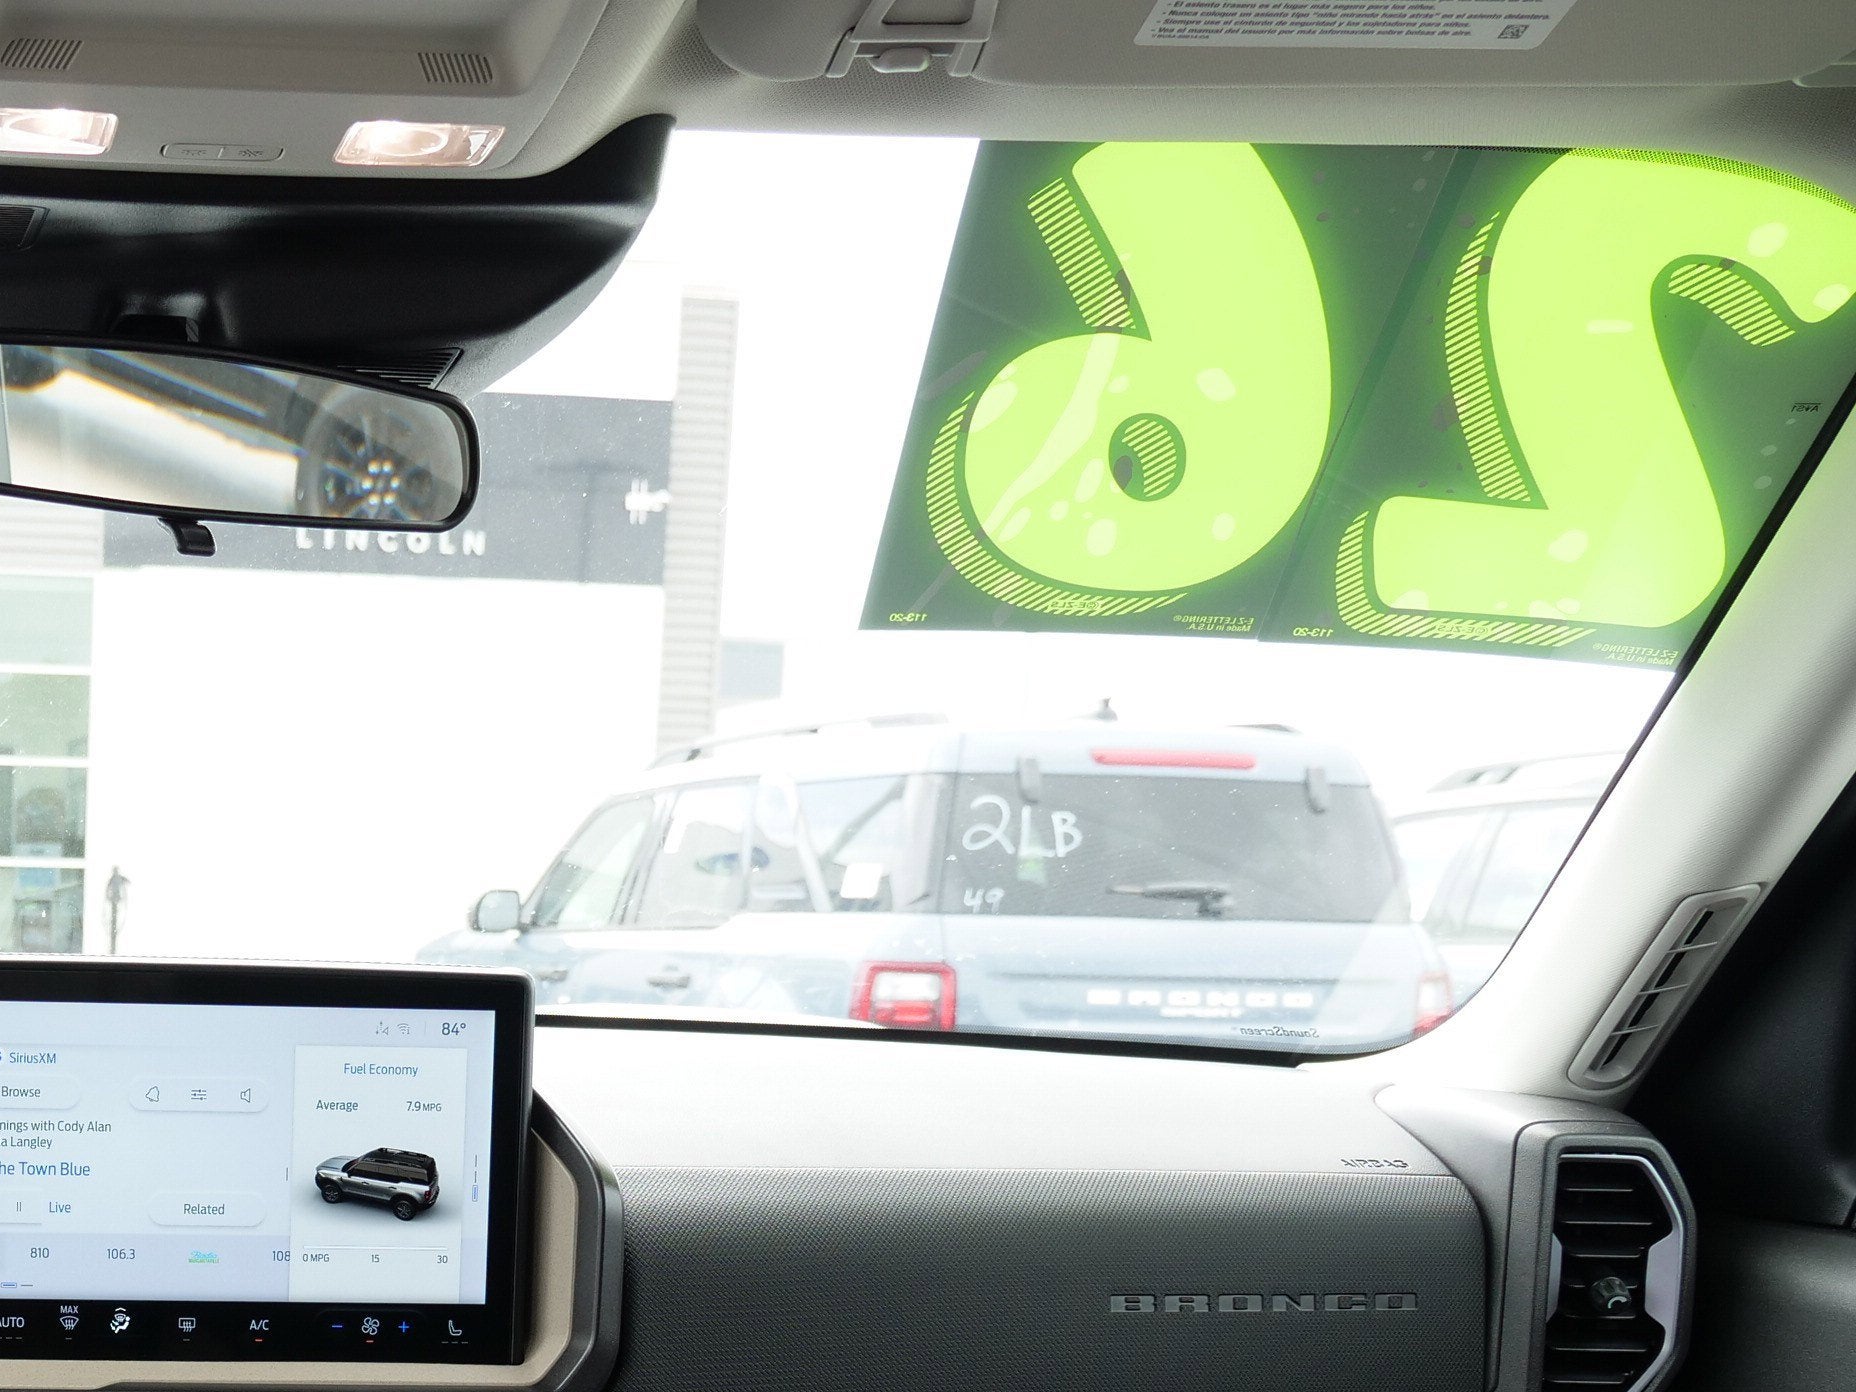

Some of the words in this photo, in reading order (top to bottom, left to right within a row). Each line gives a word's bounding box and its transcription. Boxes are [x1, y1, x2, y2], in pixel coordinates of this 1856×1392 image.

[296, 528, 486, 556] LINCOLN
[962, 794, 1083, 858] 2LB
[441, 1022, 467, 1037] 84°
[9, 1052, 57, 1065] SiriusXM
[344, 1063, 367, 1075] Fuel
[369, 1063, 418, 1077] Economy
[1, 1085, 41, 1098] Browse
[316, 1099, 359, 1113] Average
[406, 1101, 422, 1112] 7.9
[422, 1103, 442, 1112] MPG
[31, 1119, 55, 1132] with
[57, 1120, 85, 1135] Cody
[87, 1121, 112, 1133] Alan
[10, 1136, 53, 1150] Langley
[19, 1161, 57, 1176] Town
[60, 1162, 91, 1177] Blue
[48, 1201, 72, 1214] Live
[183, 1203, 226, 1216] Related
[30, 1247, 50, 1259] 810
[107, 1248, 136, 1260] 106.3
[272, 1250, 291, 1262] 108
[302, 1253, 309, 1262] 0
[310, 1253, 330, 1263] MPG
[371, 1254, 380, 1263] 15
[437, 1255, 449, 1264] 30
[1109, 1291, 1418, 1313] BRONCO
[60, 1305, 79, 1315] MAX
[249, 1318, 269, 1331] A/C
